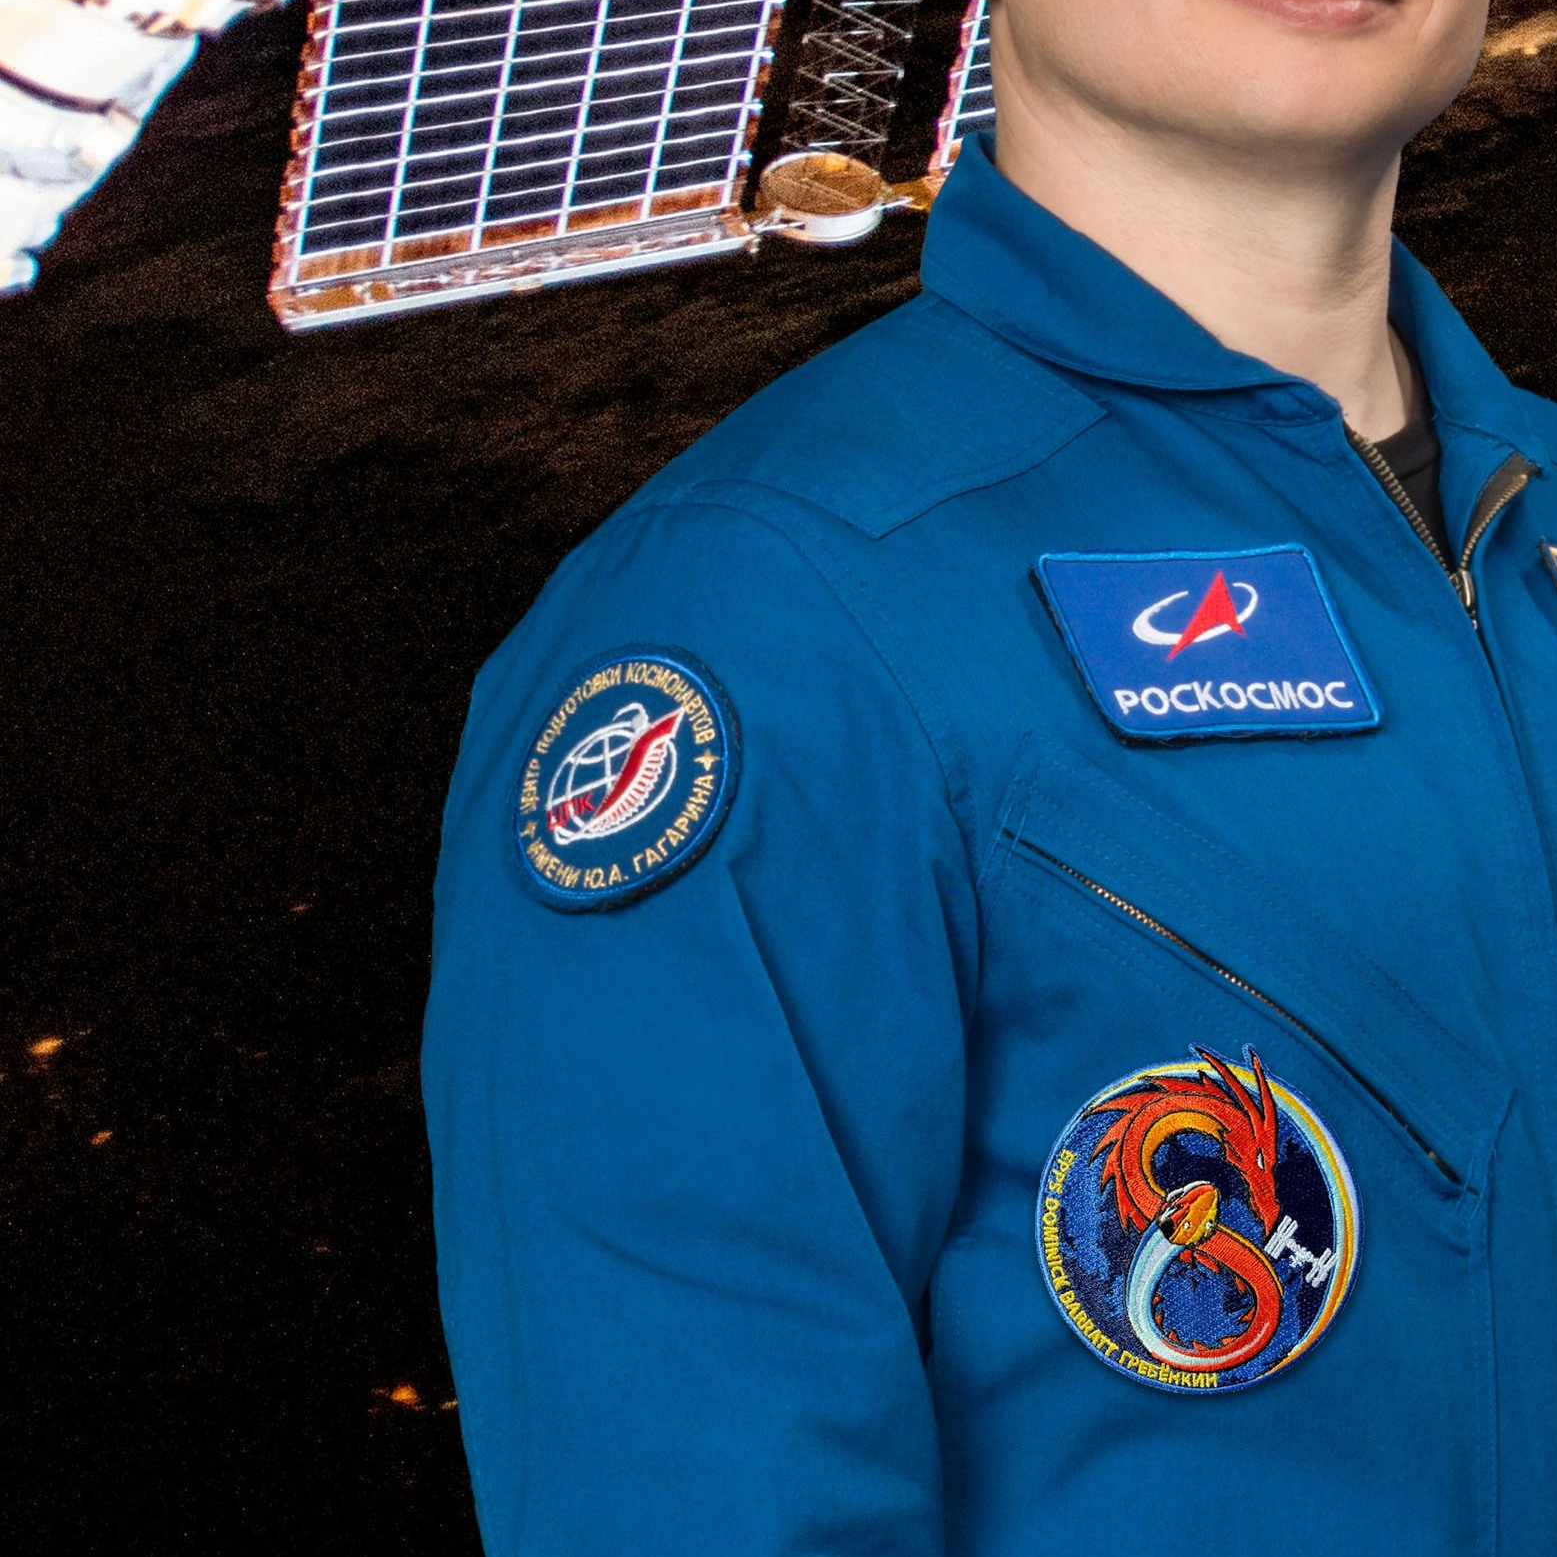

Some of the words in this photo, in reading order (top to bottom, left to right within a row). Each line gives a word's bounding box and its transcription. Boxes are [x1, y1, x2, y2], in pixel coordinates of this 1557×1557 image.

[536, 663, 623, 754] ПОДГОТОВКИ
[625, 662, 716, 744] КОСМОНАВТОВ
[1114, 681, 1354, 715] РОСКОСМОС
[526, 837, 581, 887] ИМЕНИ
[632, 774, 715, 873] ГАГАРИНА
[546, 792, 595, 831] ЦПК
[1049, 1149, 1077, 1195] EPPS
[1042, 1198, 1071, 1291] DOMINICK
[1059, 1290, 1119, 1357] BARRATT
[1118, 1350, 1219, 1388] ГРЕБЁНКИН
